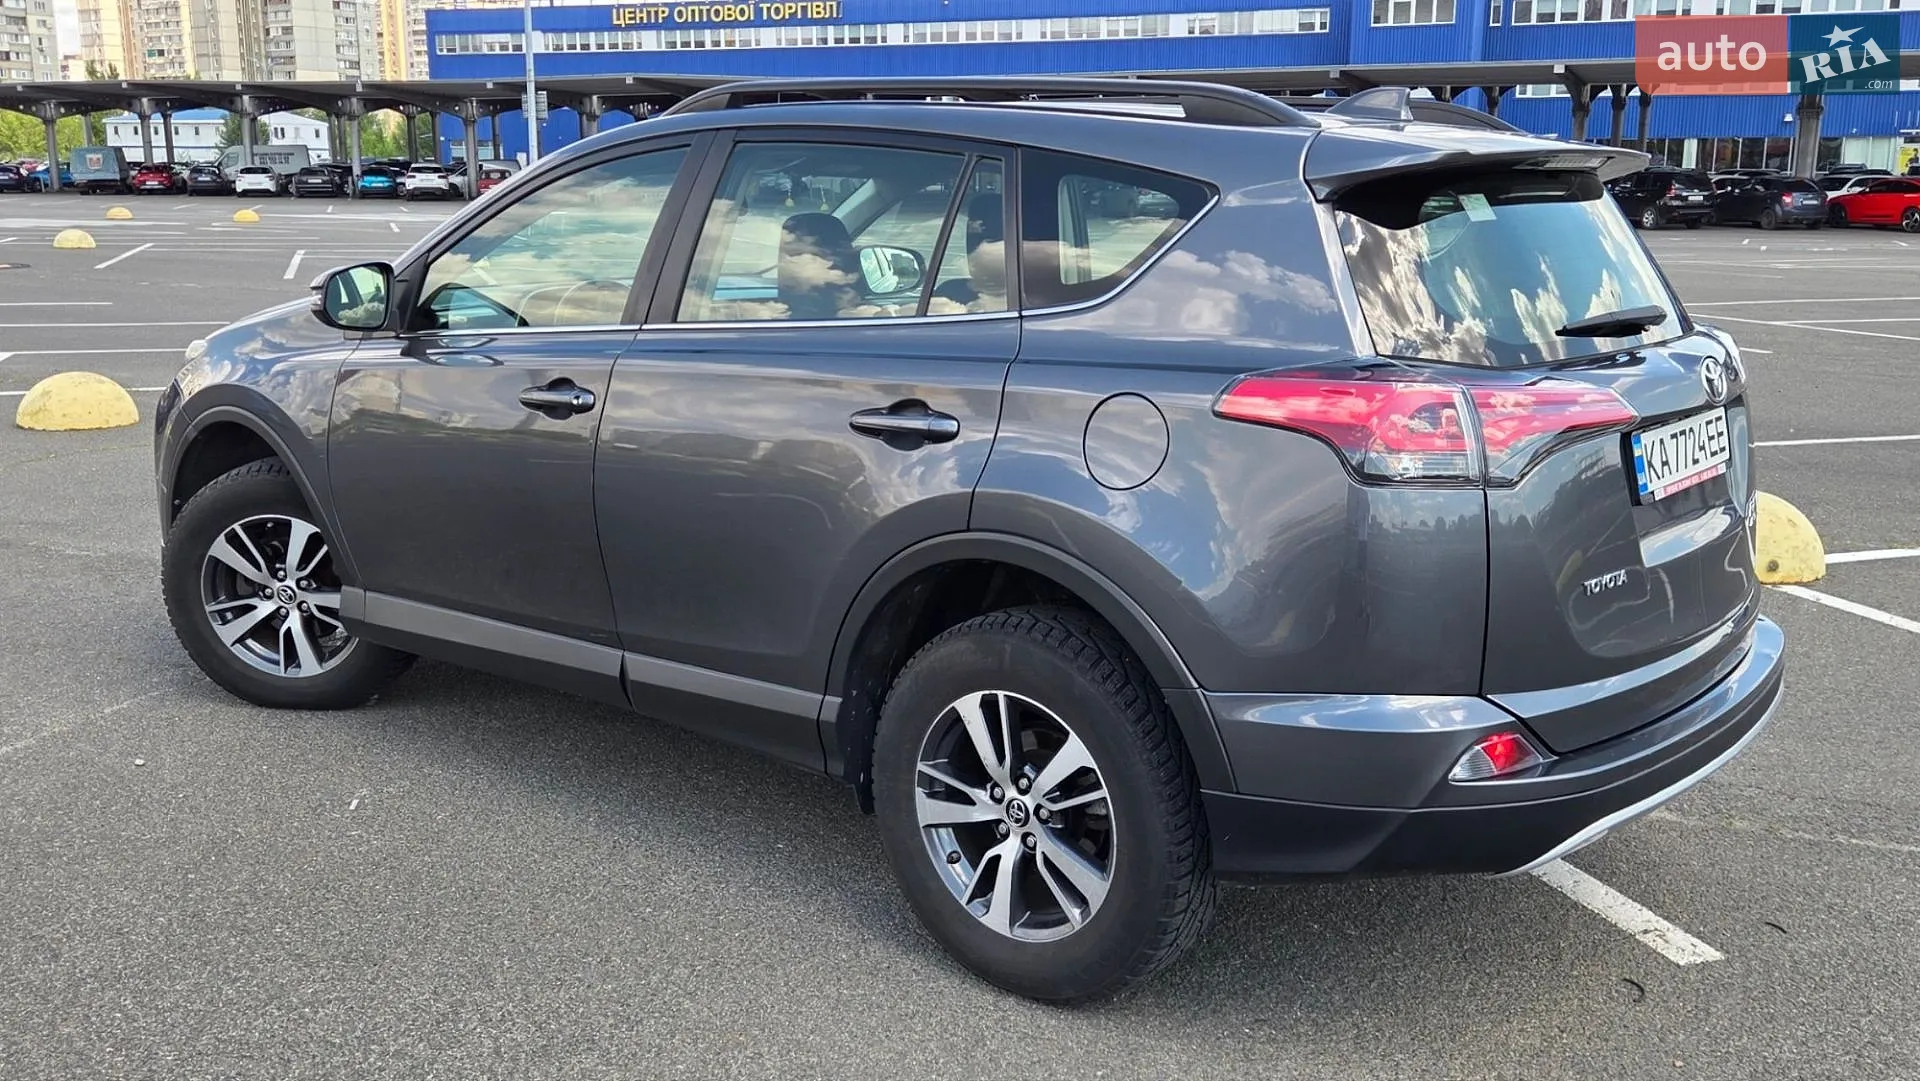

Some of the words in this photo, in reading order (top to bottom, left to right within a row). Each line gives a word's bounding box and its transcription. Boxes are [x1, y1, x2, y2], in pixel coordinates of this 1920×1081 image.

[612, 7, 670, 28] ЦЕНТР
[673, 1, 755, 23] ОПТОВОЇ
[1644, 415, 1726, 484] KA7724EE
[1583, 568, 1628, 596] TOYOTA
